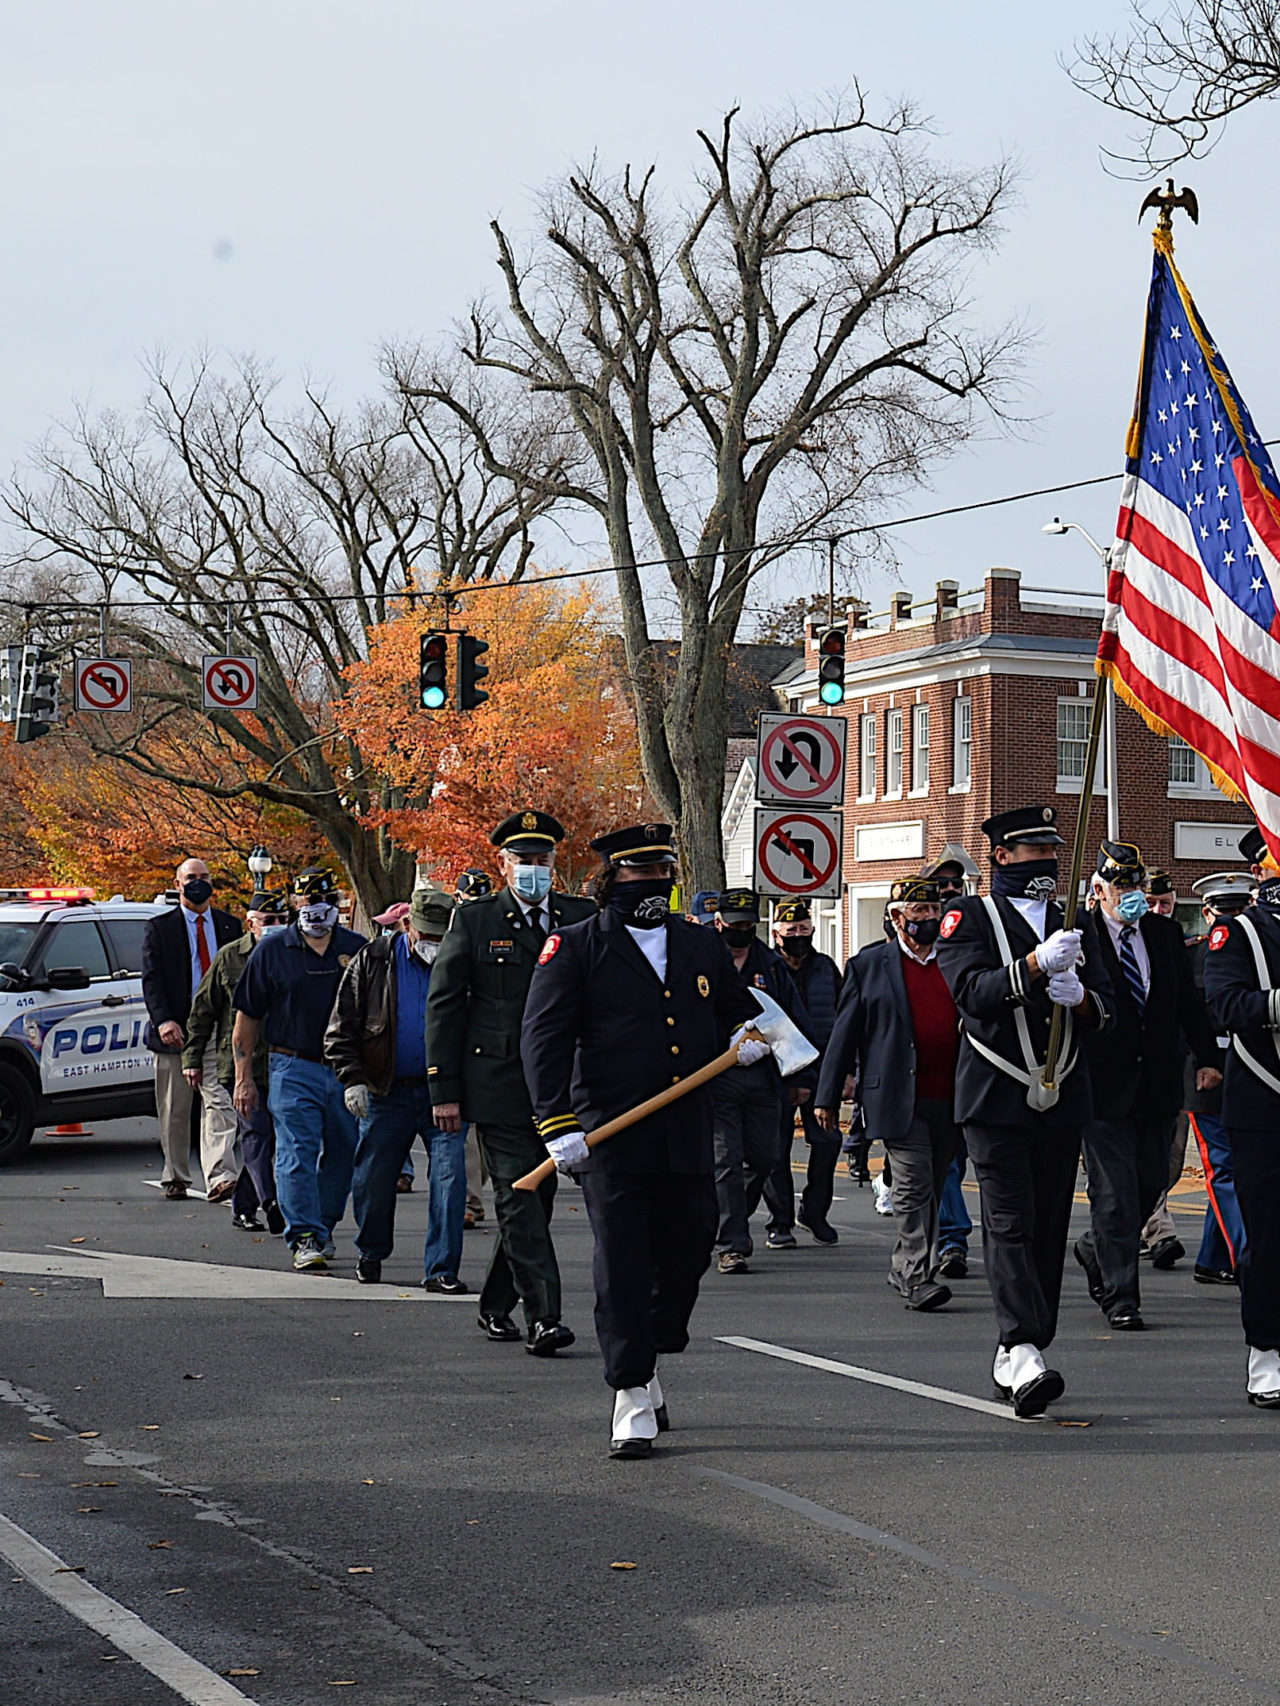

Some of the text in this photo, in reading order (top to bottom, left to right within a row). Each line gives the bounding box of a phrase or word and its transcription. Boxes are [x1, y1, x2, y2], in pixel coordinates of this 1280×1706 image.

[16, 997, 35, 1007] 414
[52, 1019, 150, 1059] POLI
[64, 1065, 90, 1078] EAST
[93, 1058, 141, 1073] HAMPTON
